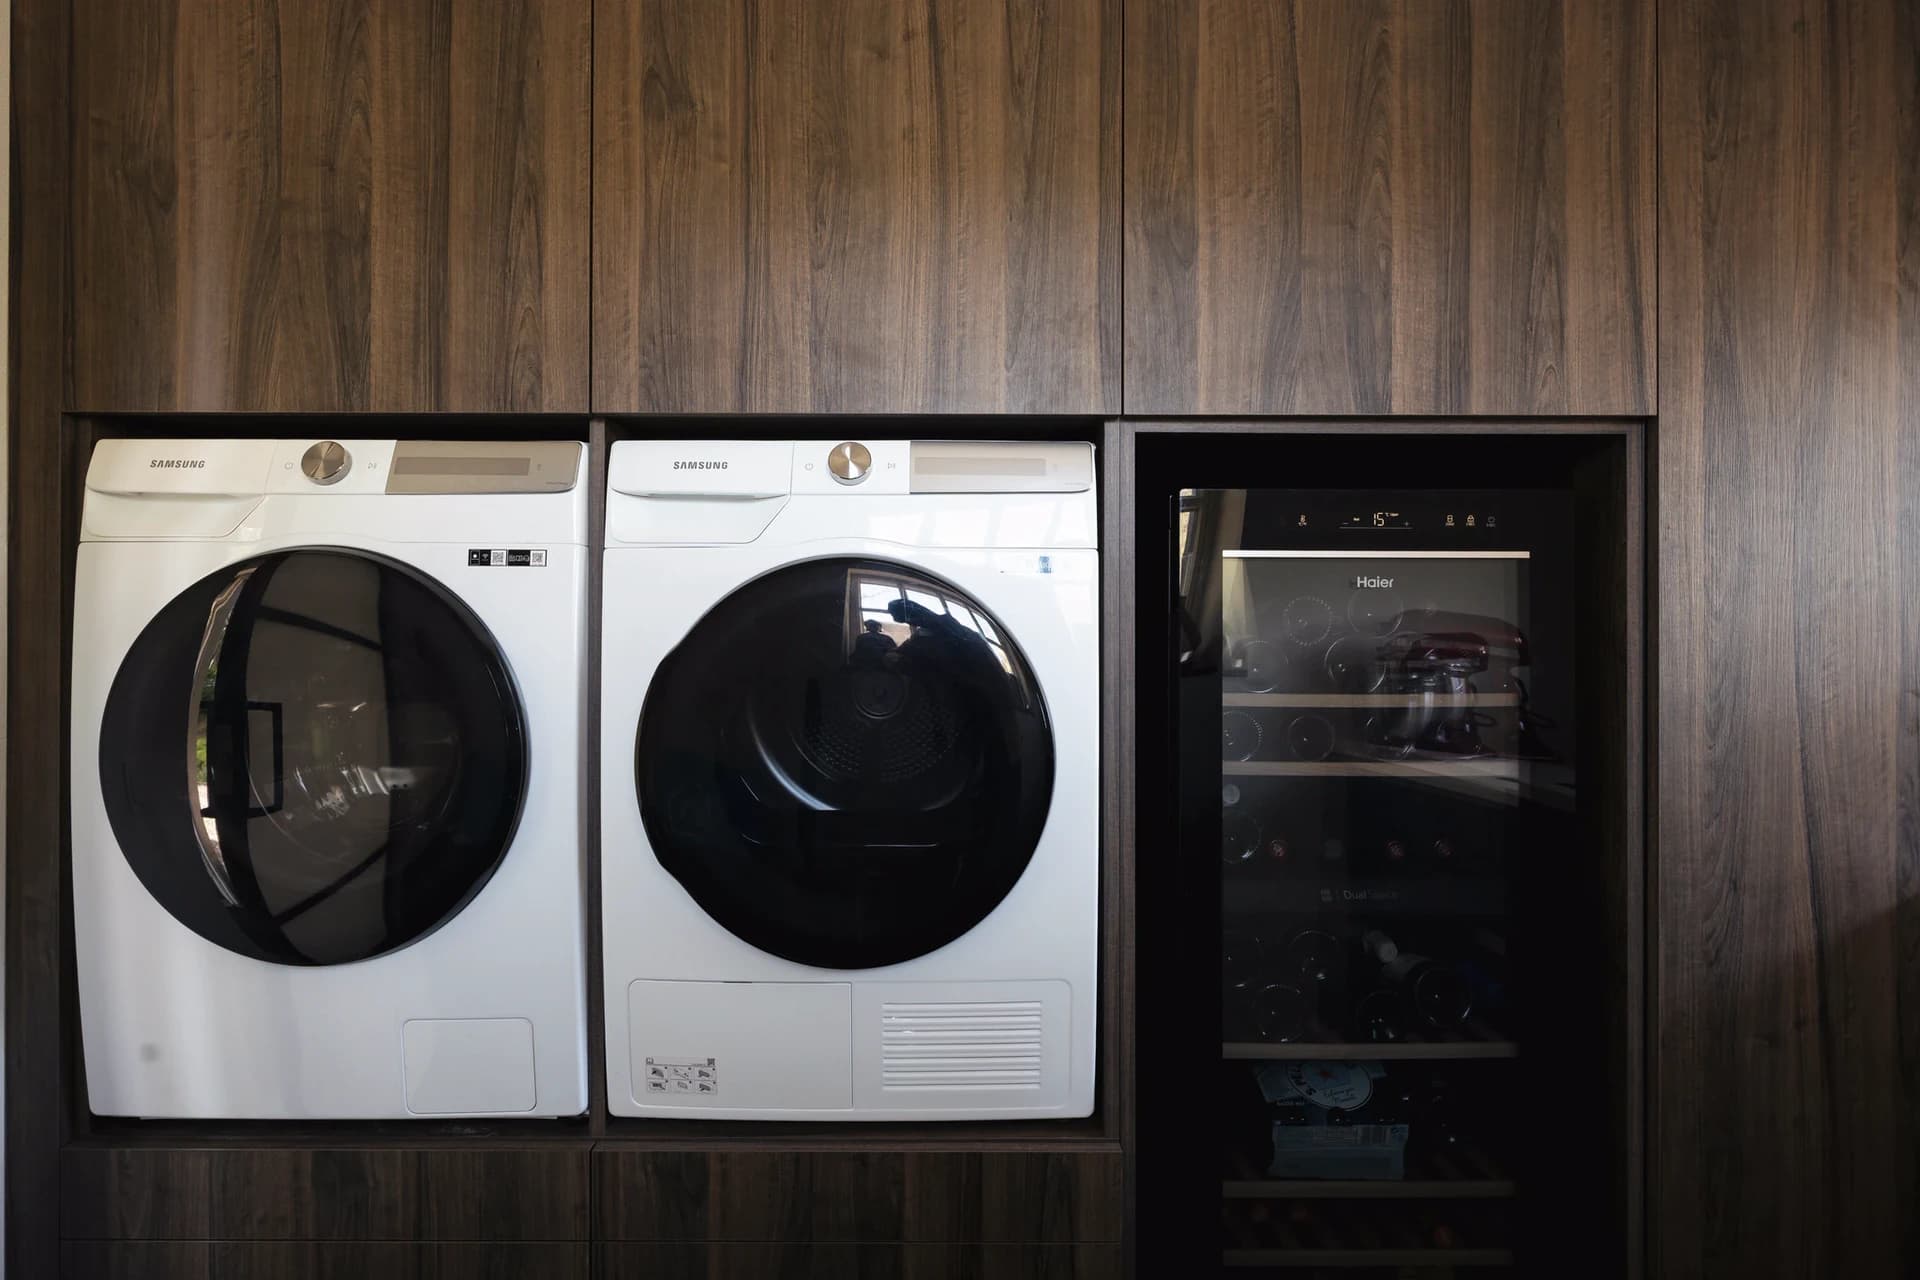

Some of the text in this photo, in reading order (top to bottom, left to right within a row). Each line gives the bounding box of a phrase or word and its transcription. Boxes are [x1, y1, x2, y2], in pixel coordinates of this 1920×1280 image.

[150, 459, 205, 468] SAMSUNG
[673, 461, 728, 470] SAMSUNG
[1357, 576, 1394, 588] Haier
